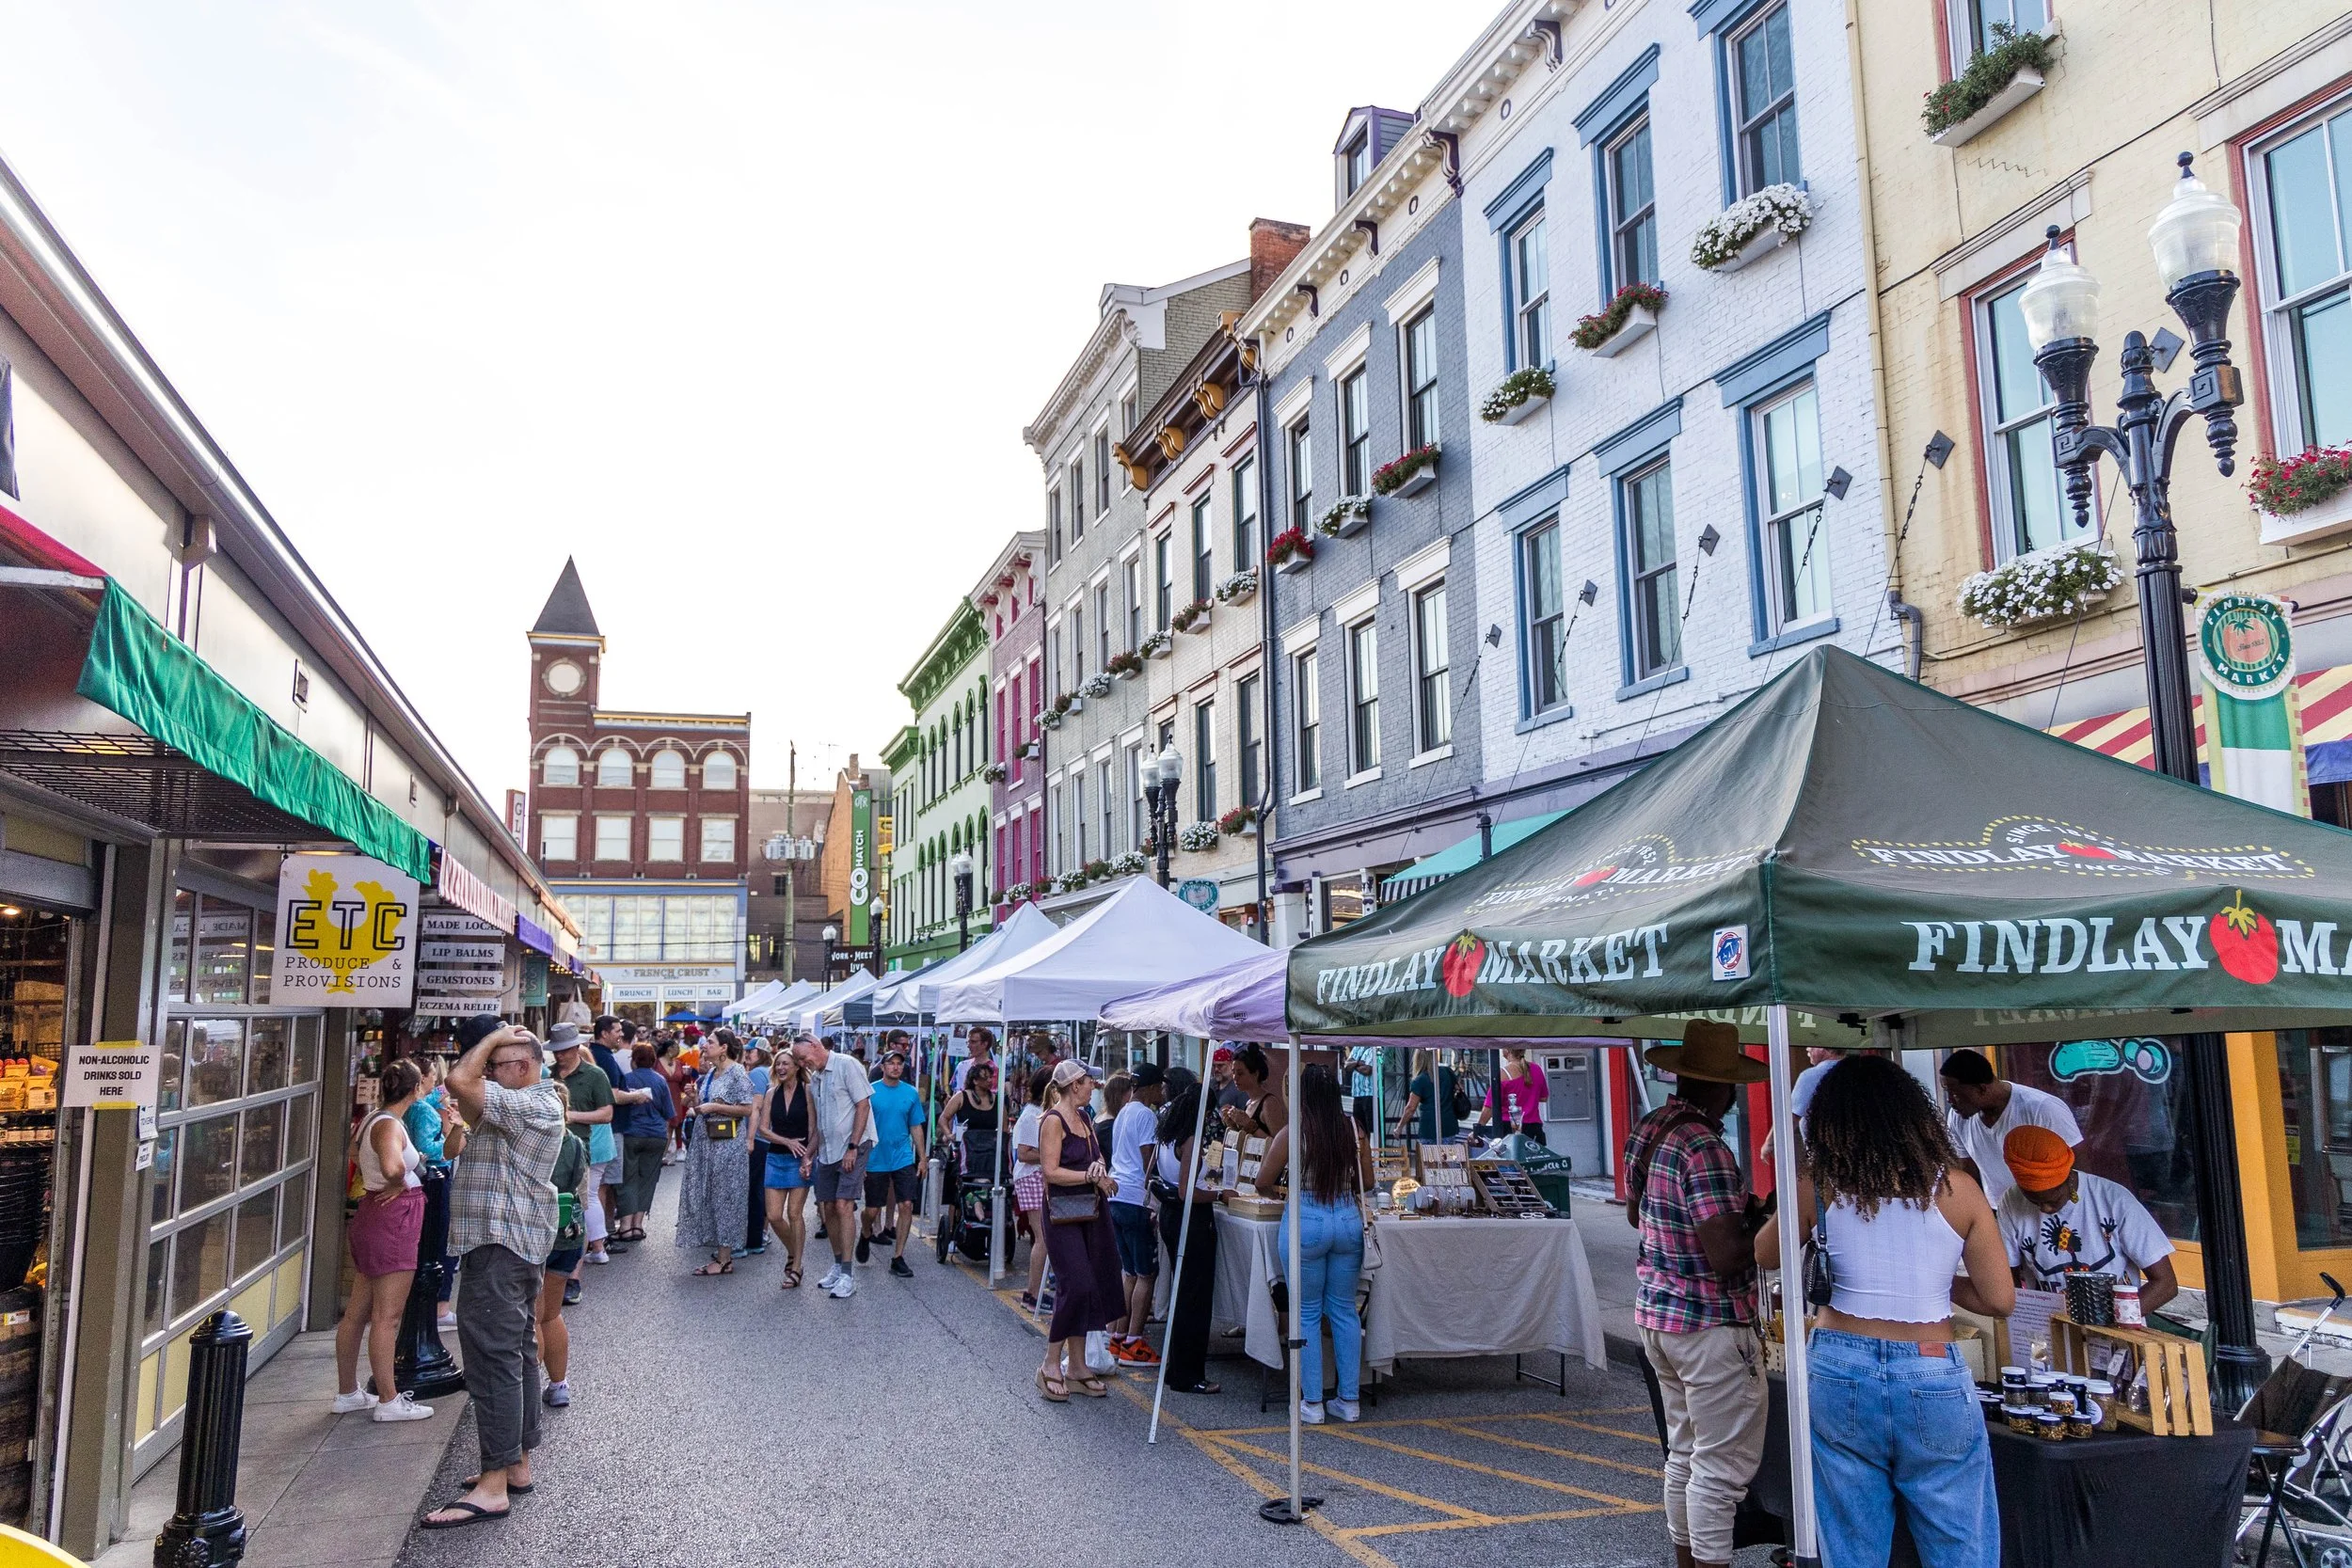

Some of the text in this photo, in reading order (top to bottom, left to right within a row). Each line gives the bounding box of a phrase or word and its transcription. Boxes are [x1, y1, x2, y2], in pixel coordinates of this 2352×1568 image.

[2206, 597, 2279, 626] FINDLAY
[2217, 653, 2285, 684] MARKET
[2006, 824, 2051, 845] SINCE
[1635, 845, 1657, 866] 1852
[1865, 844, 2296, 872] FINDLAY MARKET
[1600, 853, 1756, 885] MARKET
[285, 899, 407, 951] ETC
[426, 920, 500, 930] MADE LOCA
[1899, 915, 2211, 974] FINDLAY
[432, 948, 495, 958] LIP BALMS
[854, 951, 874, 961] MEET
[284, 956, 403, 971] PRODUCE &
[1316, 946, 1447, 1005] FINDLAY
[1477, 922, 1668, 986] MARKET
[633, 968, 710, 977] FRENCH CRUST
[282, 974, 402, 989] PROVISIONS
[426, 975, 495, 986] GEMSTONES
[667, 989, 693, 997] LUNCH
[419, 1002, 500, 1012] ECZEMA RELIEF
[78, 1054, 151, 1066] NON-ALCOHOLIC
[83, 1070, 142, 1081] DRINKS SOLD
[99, 1086, 123, 1096] HERE
